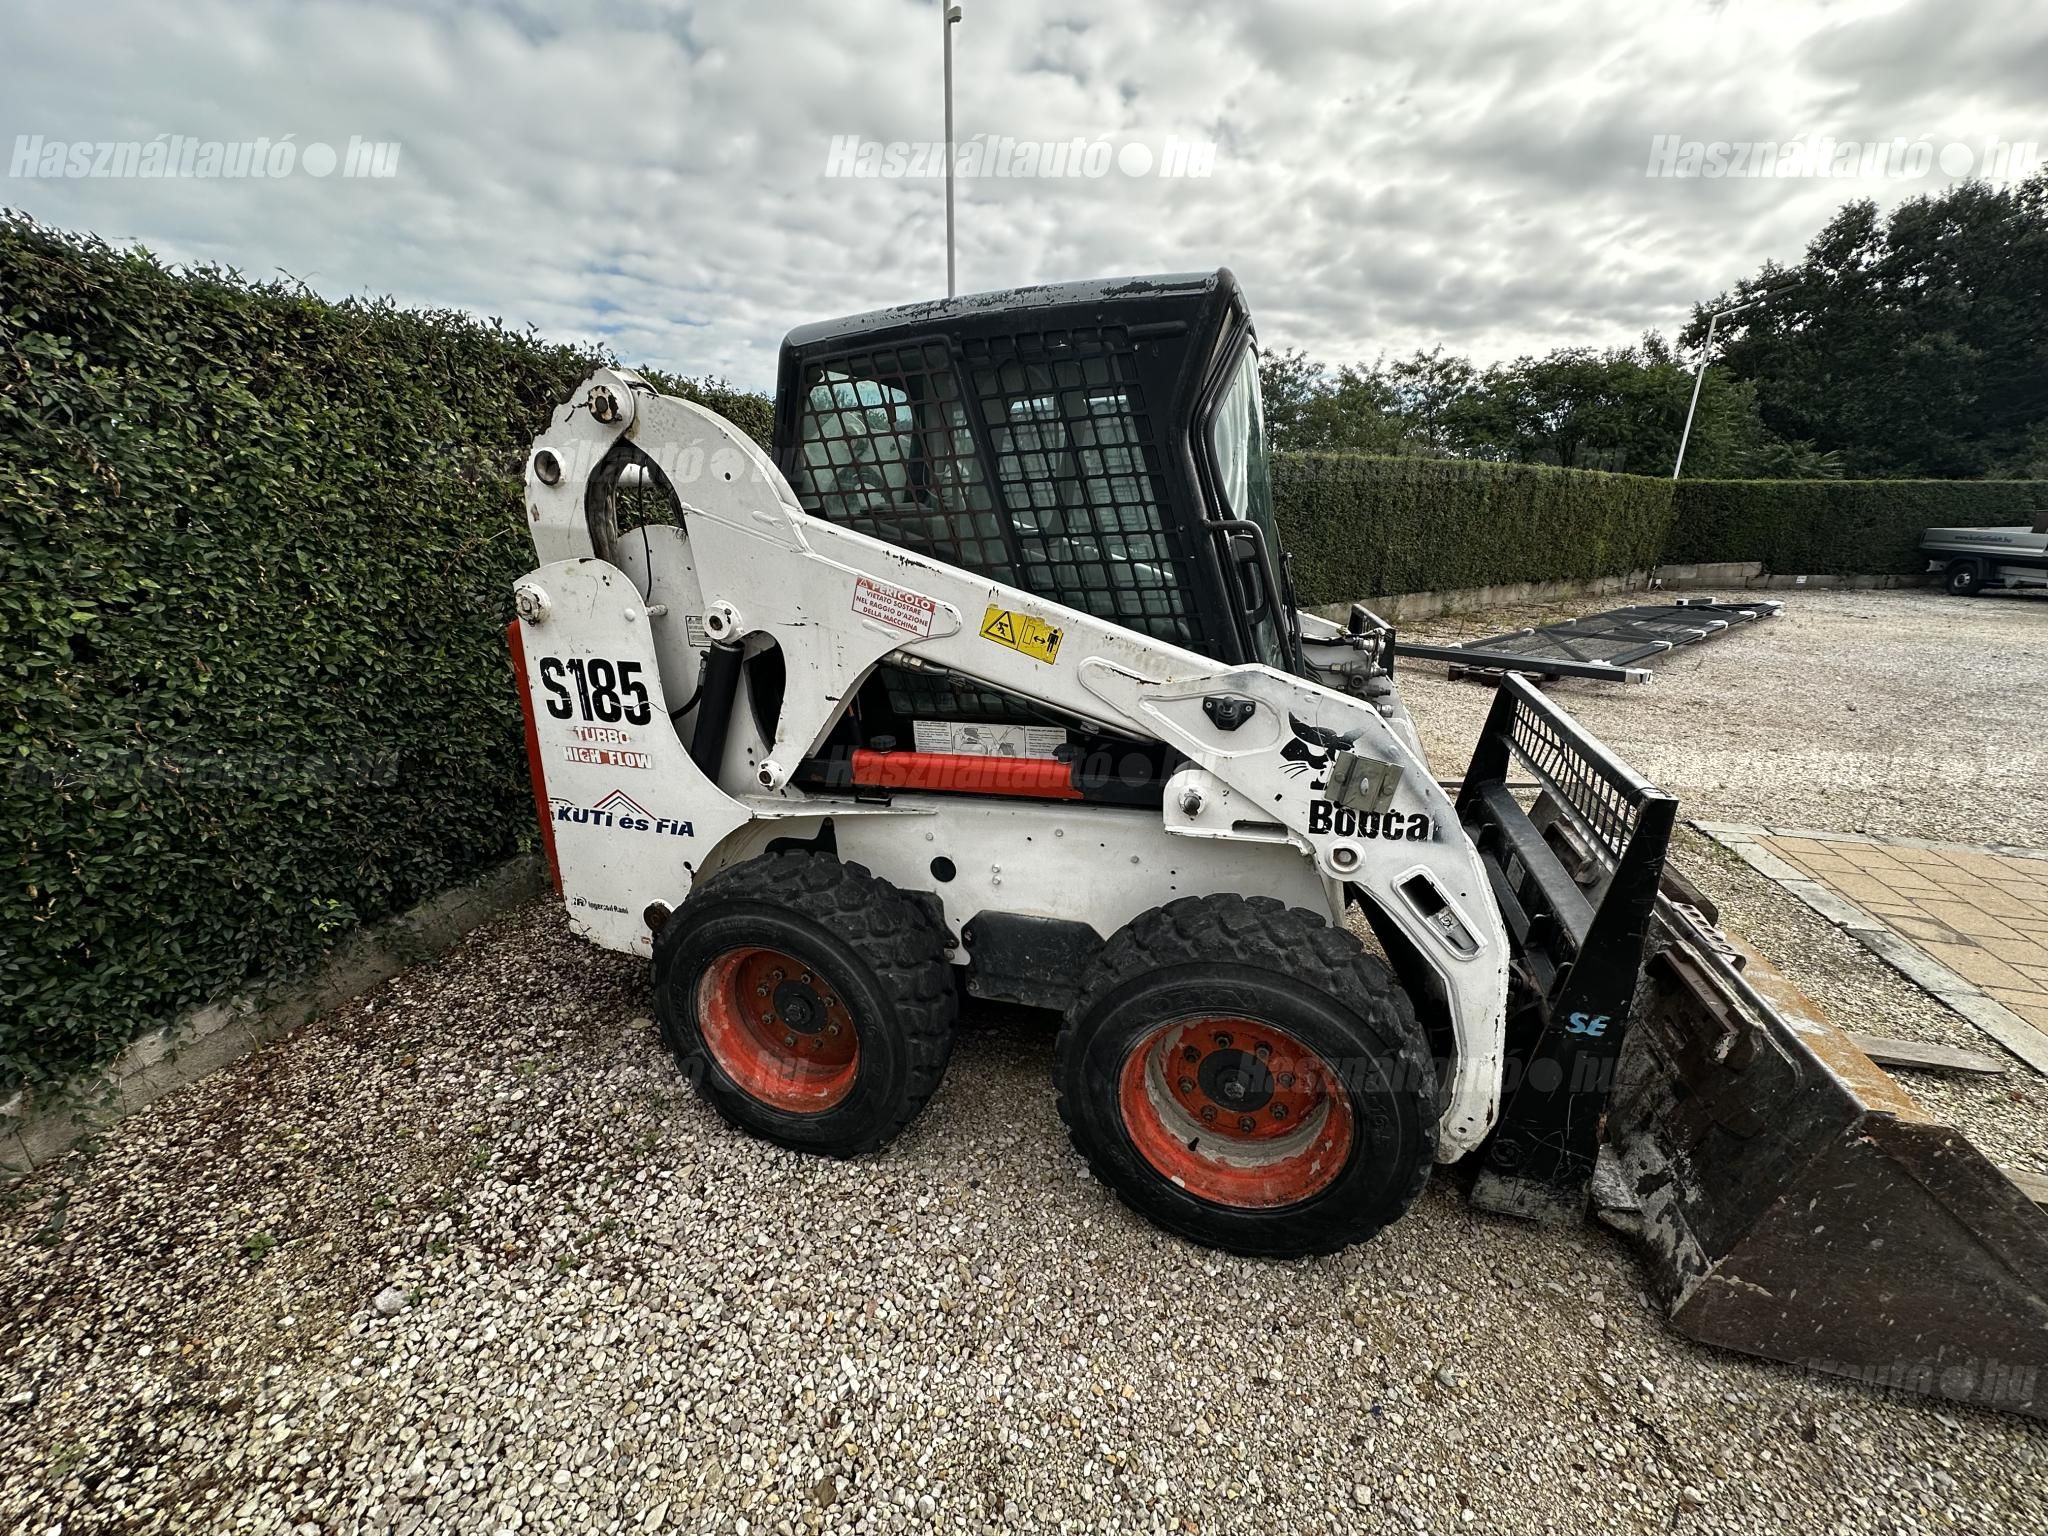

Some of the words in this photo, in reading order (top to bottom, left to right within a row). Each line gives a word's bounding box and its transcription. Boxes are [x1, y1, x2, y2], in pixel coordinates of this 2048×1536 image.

[866, 590, 892, 604] VIETATO
[894, 601, 922, 616] SOSTARE
[871, 583, 930, 610] PERICOLO
[856, 596, 868, 605] NEL
[870, 600, 896, 614] RAGGIO
[897, 611, 928, 627] D'AZIONE
[863, 607, 882, 618] DELLA
[883, 614, 918, 632] MACCHINA
[540, 657, 651, 725] S185
[575, 727, 631, 745] TURBO
[563, 746, 603, 765] HIGH
[605, 749, 652, 769] FLOW
[619, 813, 650, 831] és
[1309, 799, 1431, 842] Bobca
